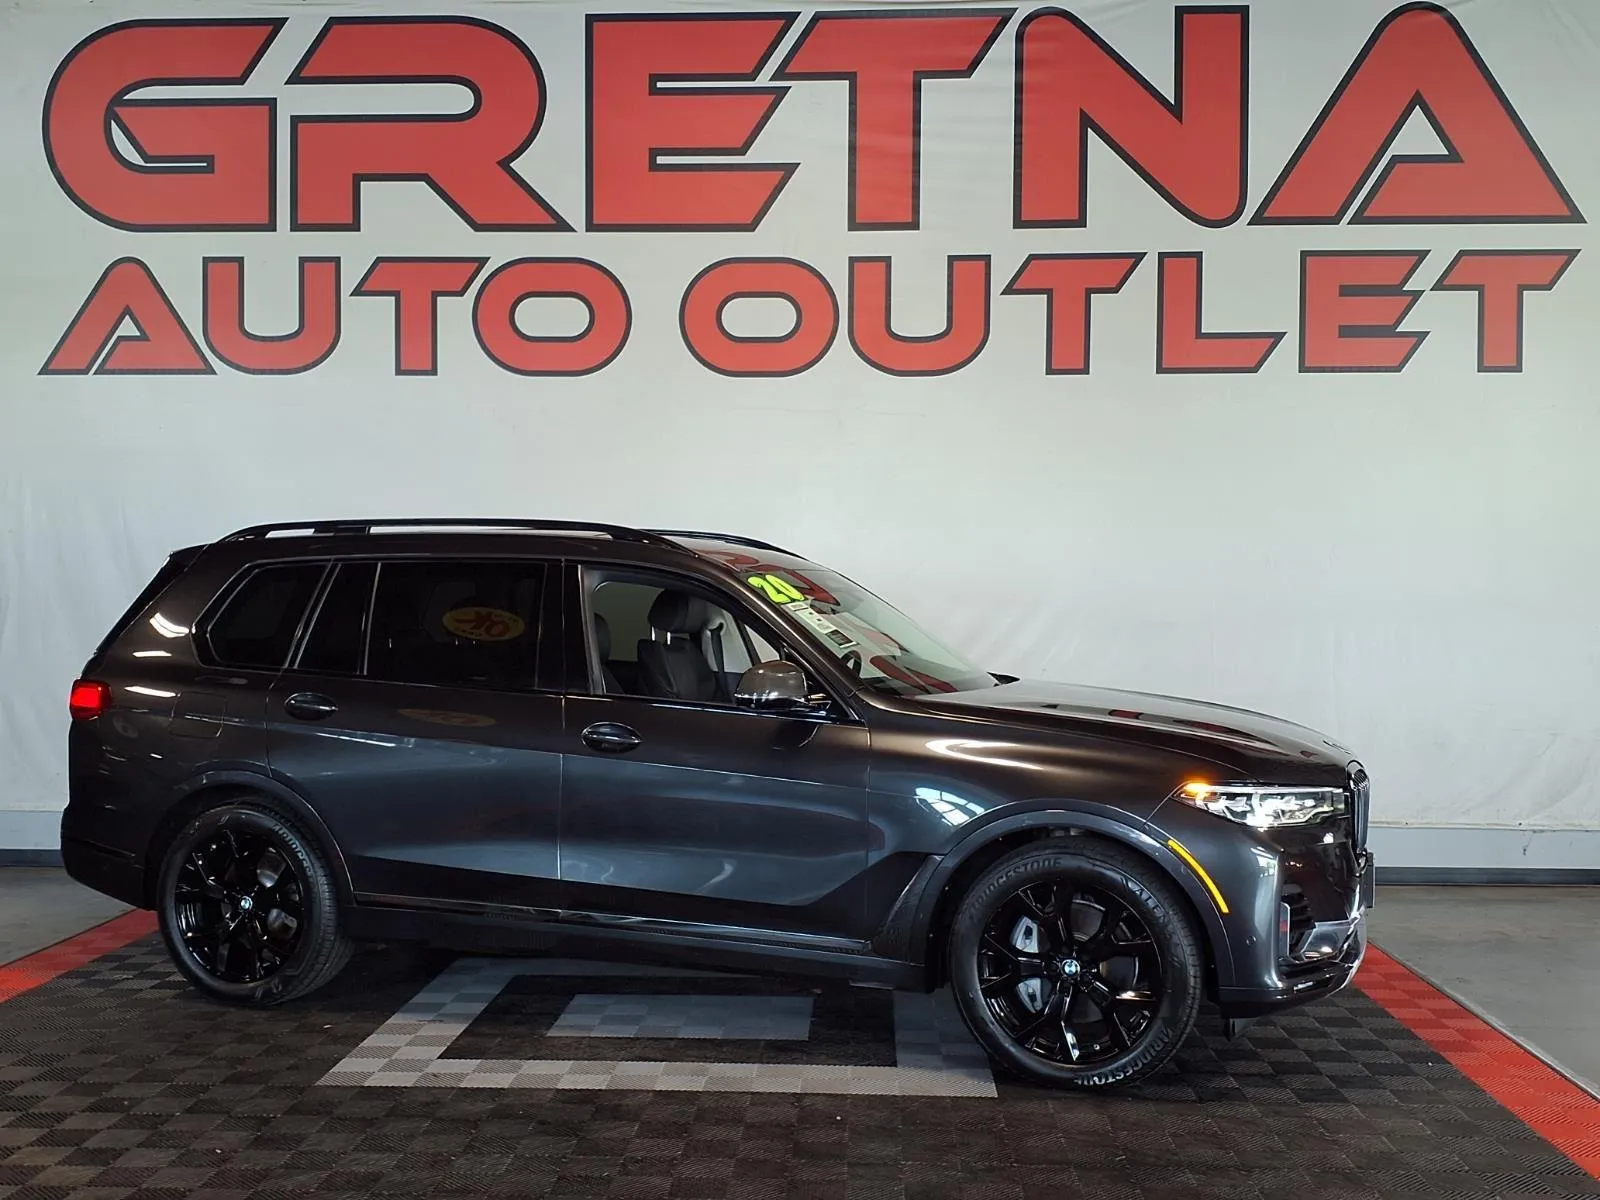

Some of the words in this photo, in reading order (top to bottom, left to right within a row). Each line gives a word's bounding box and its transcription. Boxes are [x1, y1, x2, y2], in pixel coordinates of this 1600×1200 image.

[42, 2, 1587, 232] GRETNA
[37, 256, 632, 376] AUTO
[679, 249, 1582, 377] OUTLET
[747, 573, 808, 605] 20
